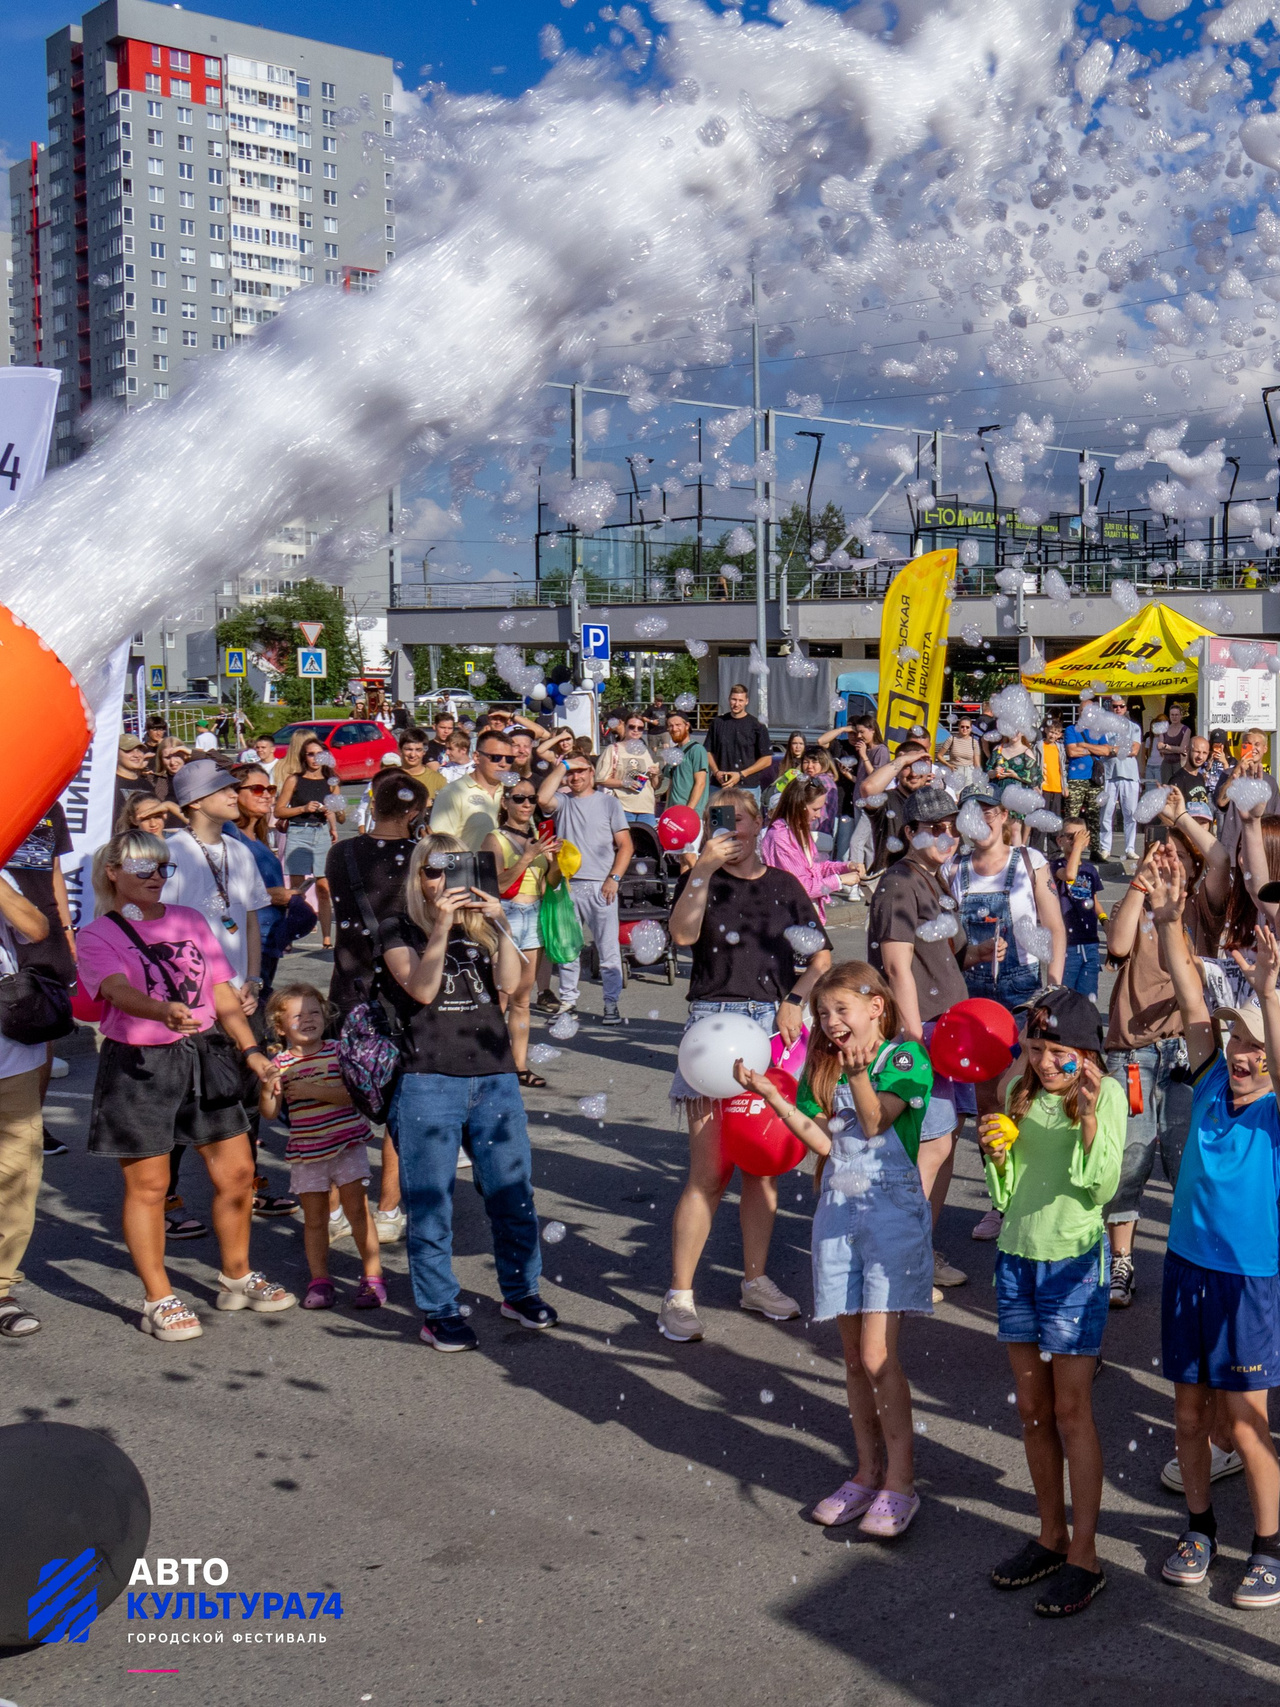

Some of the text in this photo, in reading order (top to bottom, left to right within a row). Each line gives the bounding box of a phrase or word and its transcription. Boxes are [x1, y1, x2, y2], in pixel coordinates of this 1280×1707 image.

[589, 628, 605, 656] P
[895, 594, 911, 688] УРАЬСКАЯ
[919, 631, 932, 698] ДРИФТА
[1033, 677, 1092, 687] УРАЛЬСКА
[1231, 1363, 1262, 1373] KELME
